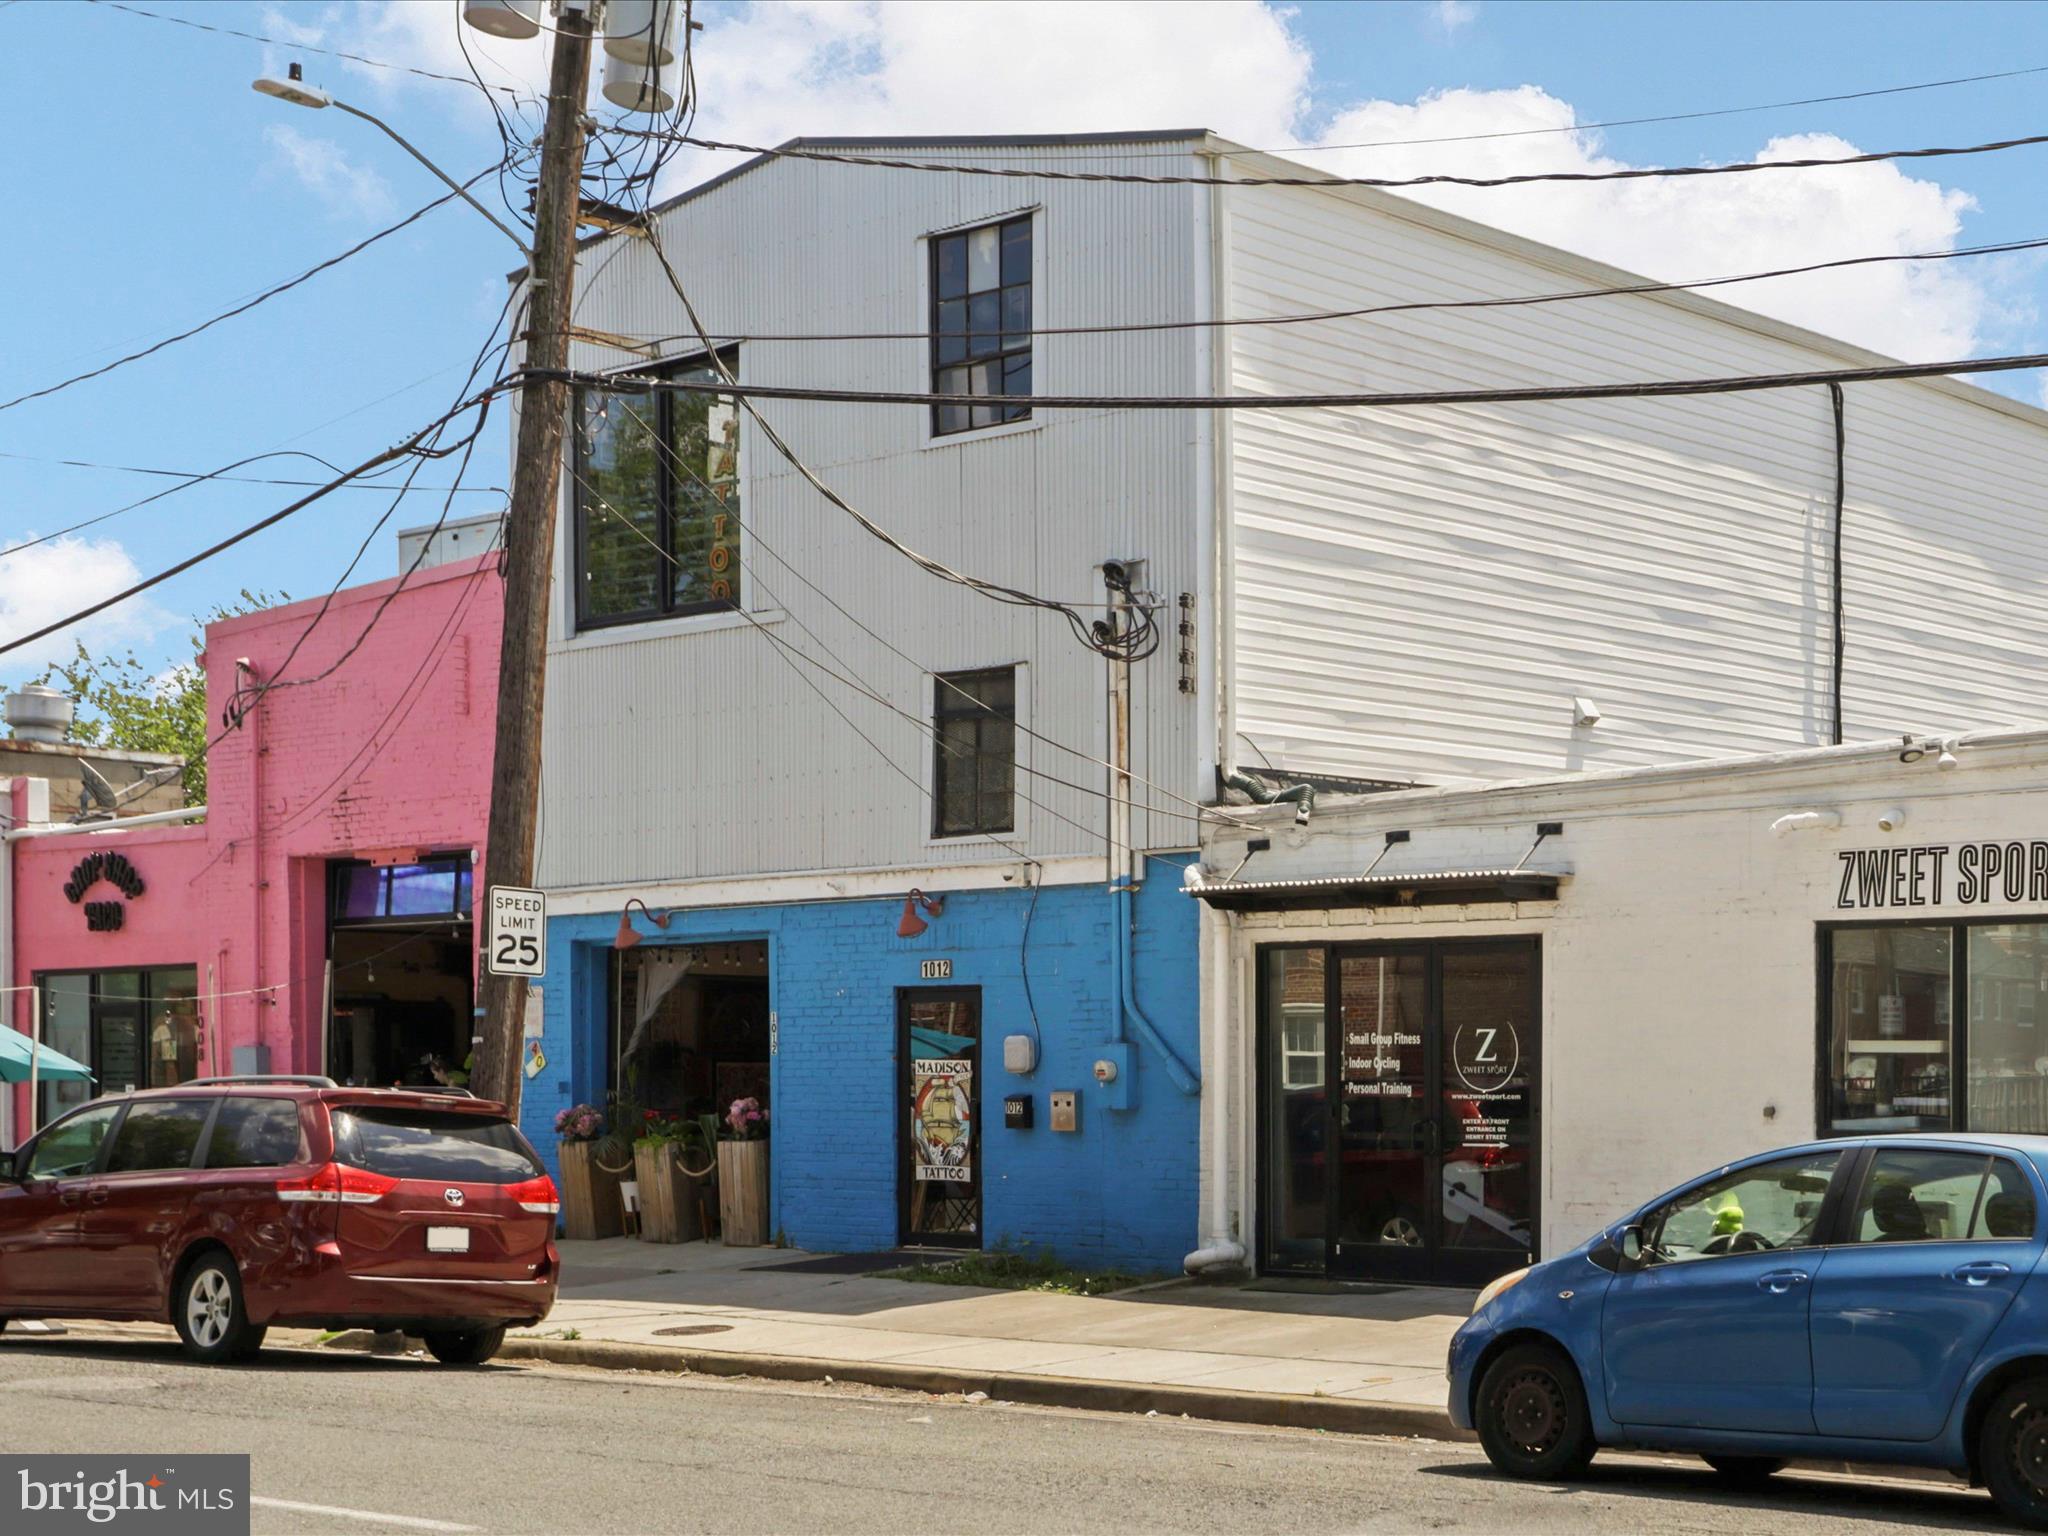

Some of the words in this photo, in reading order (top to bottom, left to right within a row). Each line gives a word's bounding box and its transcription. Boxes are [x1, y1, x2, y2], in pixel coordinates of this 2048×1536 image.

[709, 419, 737, 600] TATTOO
[1837, 846, 1949, 909] ZWEET
[495, 896, 542, 912] SPEED
[500, 915, 536, 930] LIMIT
[496, 933, 539, 966] 25
[922, 961, 950, 978] 1012
[770, 1011, 778, 1055] 1012
[1349, 1032, 1370, 1045] Small
[1370, 1032, 1393, 1047] Group
[1394, 1032, 1421, 1045] Fitness
[1474, 1028, 1498, 1062] Z
[917, 1061, 970, 1074] MADISON
[1348, 1056, 1372, 1069] Indoor
[1373, 1056, 1401, 1072] Cycling
[1462, 1065, 1486, 1074] ZWEET
[1348, 1082, 1380, 1094] Personal
[1381, 1082, 1412, 1097] Training
[1451, 1093, 1522, 1101] www.zweetsport.com
[1005, 1101, 1024, 1114] 1012
[923, 1166, 965, 1180] TATTOO
